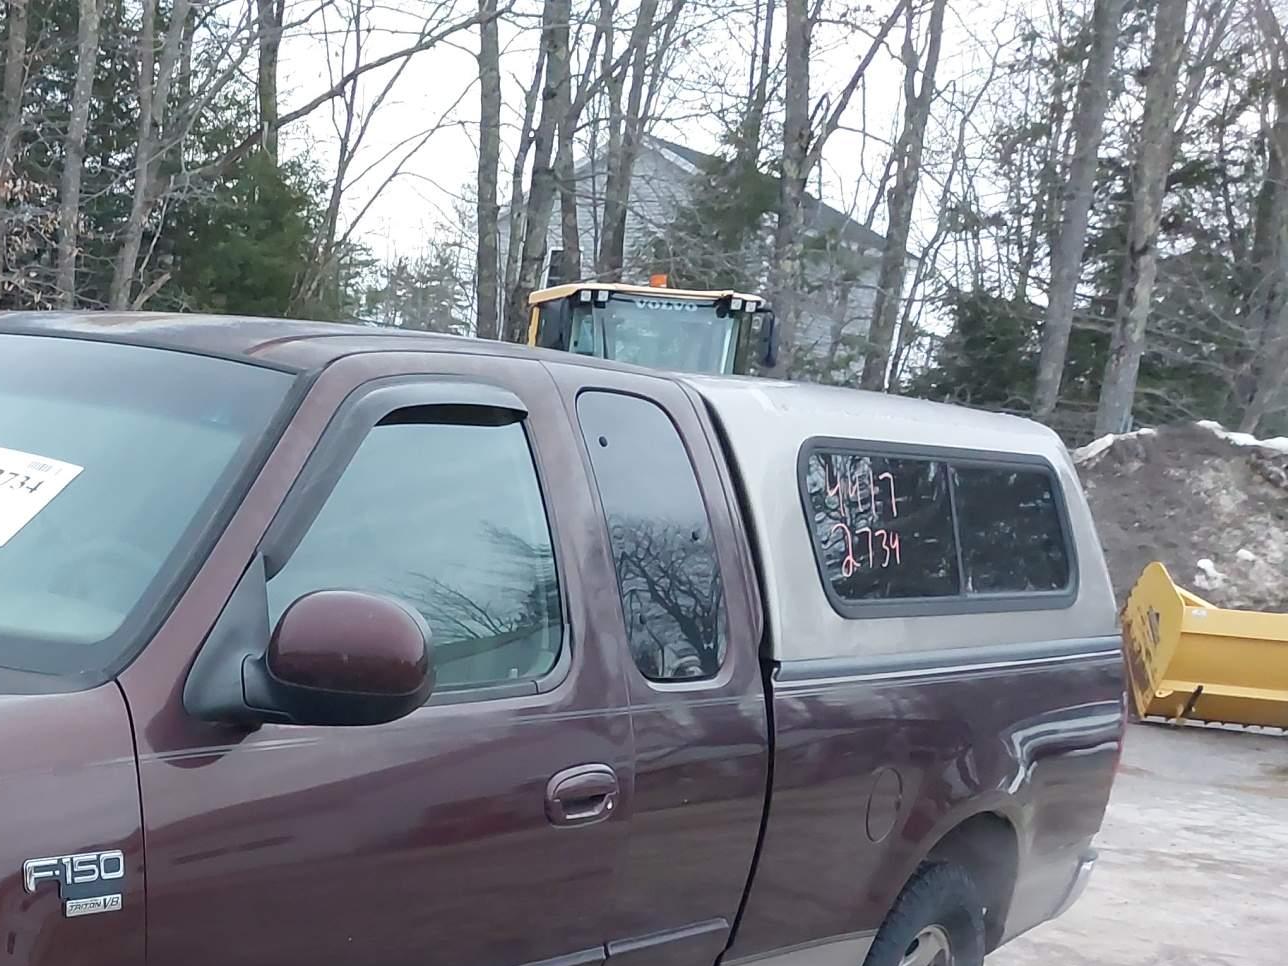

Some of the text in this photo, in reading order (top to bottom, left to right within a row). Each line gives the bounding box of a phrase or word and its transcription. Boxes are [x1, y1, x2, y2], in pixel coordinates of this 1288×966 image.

[635, 299, 698, 312] VOLVO
[825, 463, 897, 517] 4417
[831, 523, 901, 577] 2734
[68, 896, 120, 914] TRITON V8
